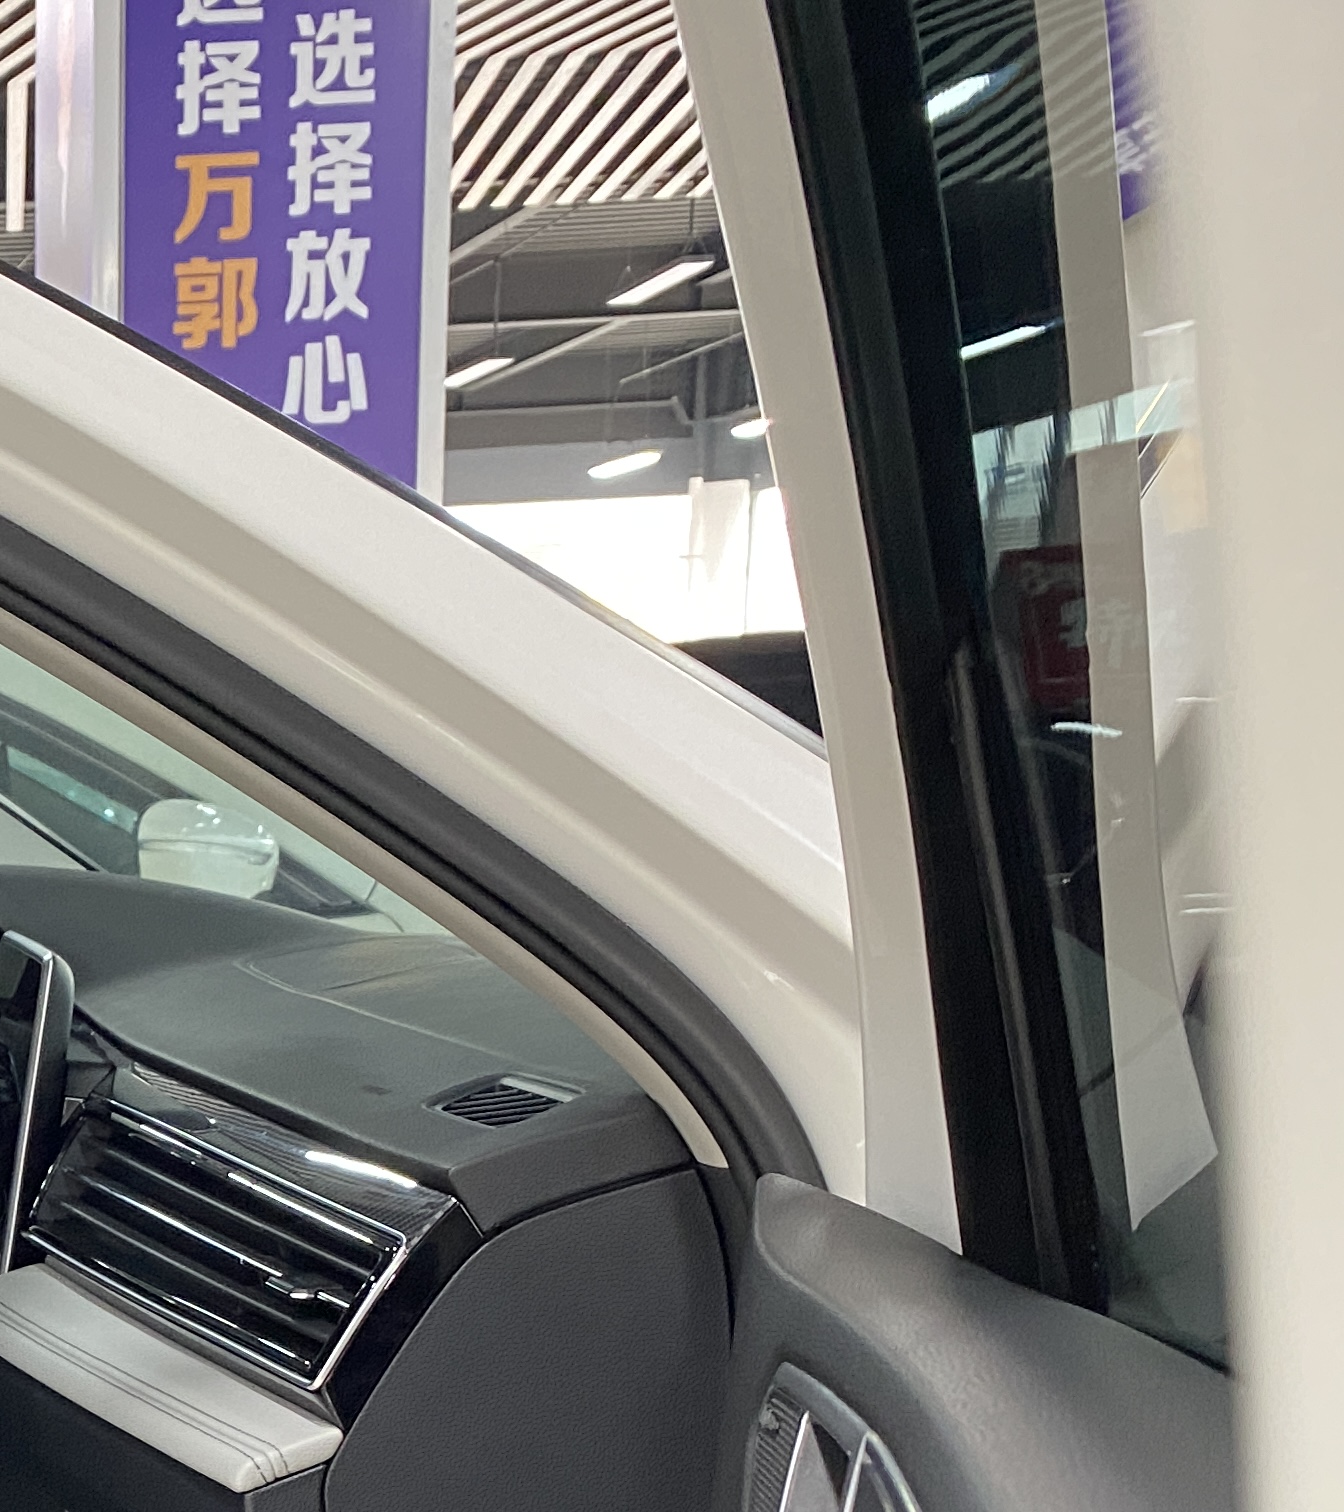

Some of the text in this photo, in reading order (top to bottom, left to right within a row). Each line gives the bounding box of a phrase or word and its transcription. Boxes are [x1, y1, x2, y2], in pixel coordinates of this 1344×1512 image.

[172, 0, 263, 350] 择万郭
[282, 8, 376, 424] 选择放心
